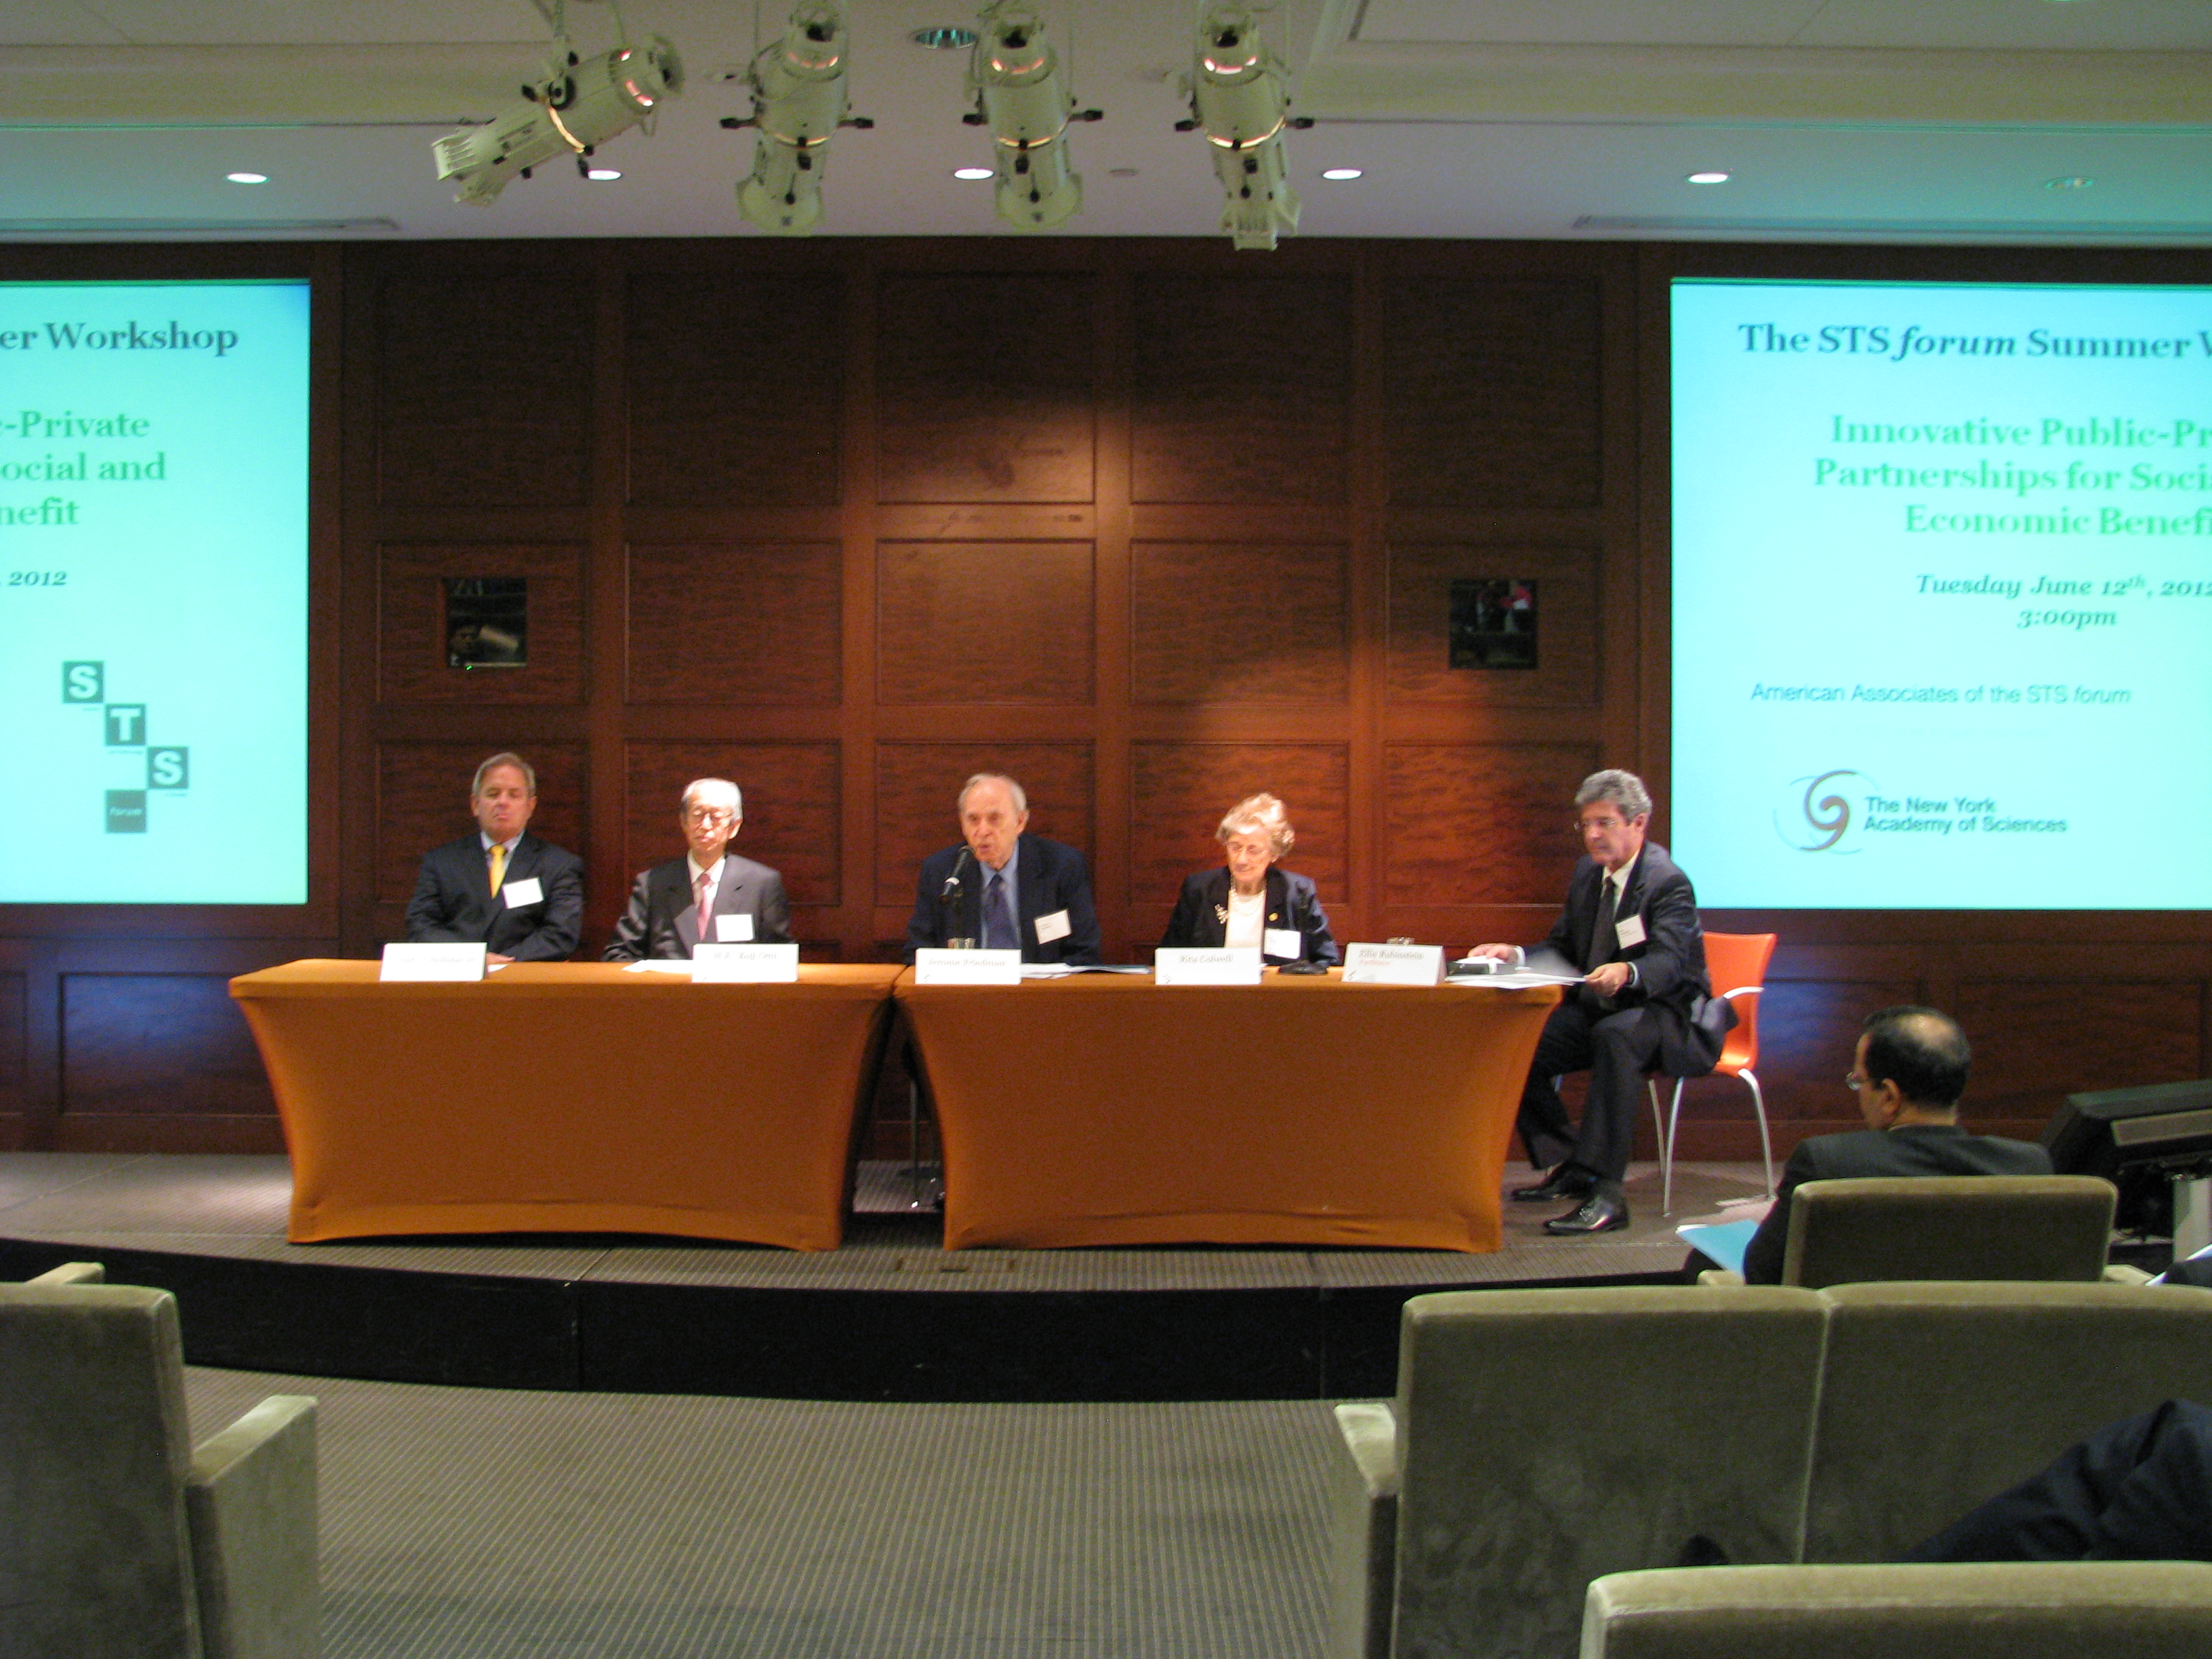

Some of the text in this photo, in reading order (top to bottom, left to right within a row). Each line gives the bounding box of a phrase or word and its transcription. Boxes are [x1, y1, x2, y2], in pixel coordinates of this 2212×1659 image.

[43, 319, 239, 358] Workshop
[1738, 322, 1811, 352] The
[1818, 325, 1891, 354] STS
[1891, 325, 2017, 363] forum
[2027, 329, 2194, 359] Summer
[0, 410, 150, 438] -Private
[1832, 414, 2032, 445] Innovative
[98, 451, 165, 480] and
[1815, 457, 2212, 497] Partnerships for Soci
[1906, 504, 2091, 535] Economic
[7, 571, 67, 587] 2012
[1917, 573, 2023, 600] Tuesday
[2030, 575, 2093, 596] June
[2017, 610, 2117, 632] 3:00pm
[68, 664, 99, 699] S
[1750, 682, 2133, 705] American Associates of the STS forum
[110, 708, 142, 742] T
[153, 750, 184, 786] S
[1865, 796, 1996, 813] The New York
[1864, 815, 2068, 836] Academy of Sciences
